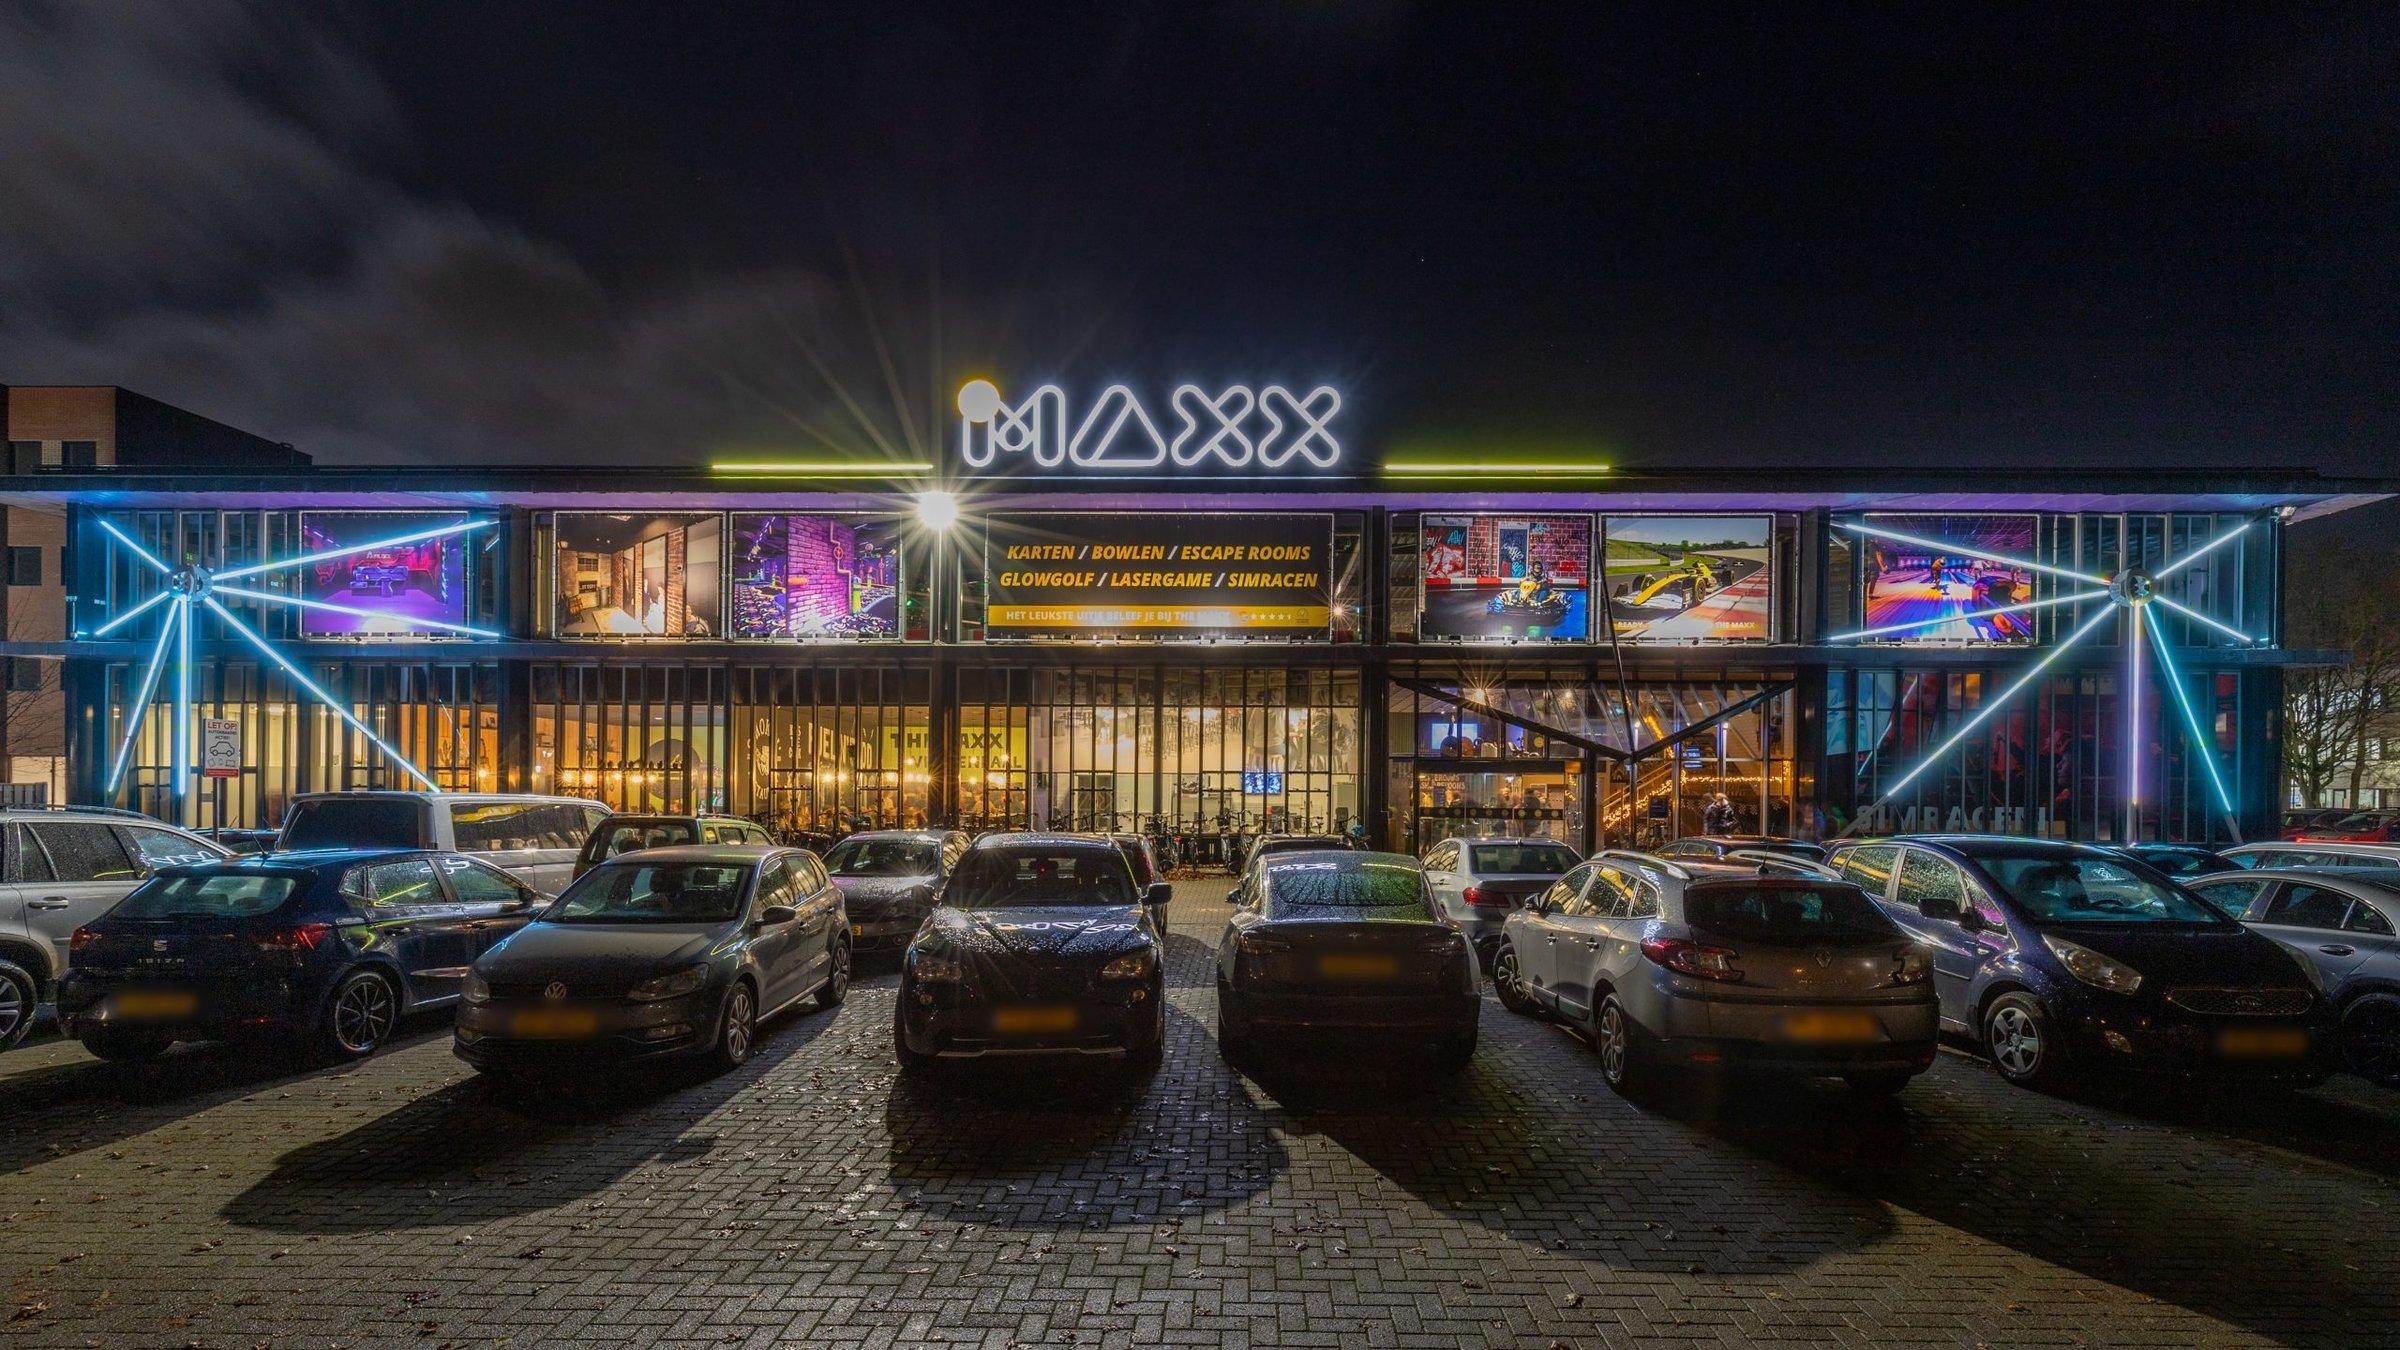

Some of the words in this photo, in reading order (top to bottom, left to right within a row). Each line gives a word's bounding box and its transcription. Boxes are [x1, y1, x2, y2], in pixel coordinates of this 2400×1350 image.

[1007, 545, 1075, 560] KARTEN
[1091, 545, 1165, 560] BOWLEN
[1181, 545, 1245, 560] ESCAPE
[1248, 545, 1311, 560] ROOMS
[1000, 572, 1095, 587] GLOWGOLF
[1110, 572, 1212, 587] LASERGAME
[1228, 572, 1318, 587] SIMRACEN
[1006, 611, 1026, 620] HET
[1029, 611, 1073, 620] LEUKSTE
[1144, 611, 1155, 622] JE
[1157, 611, 1172, 622] BIJ
[208, 721, 222, 729] LET
[960, 733, 1003, 748] AXX
